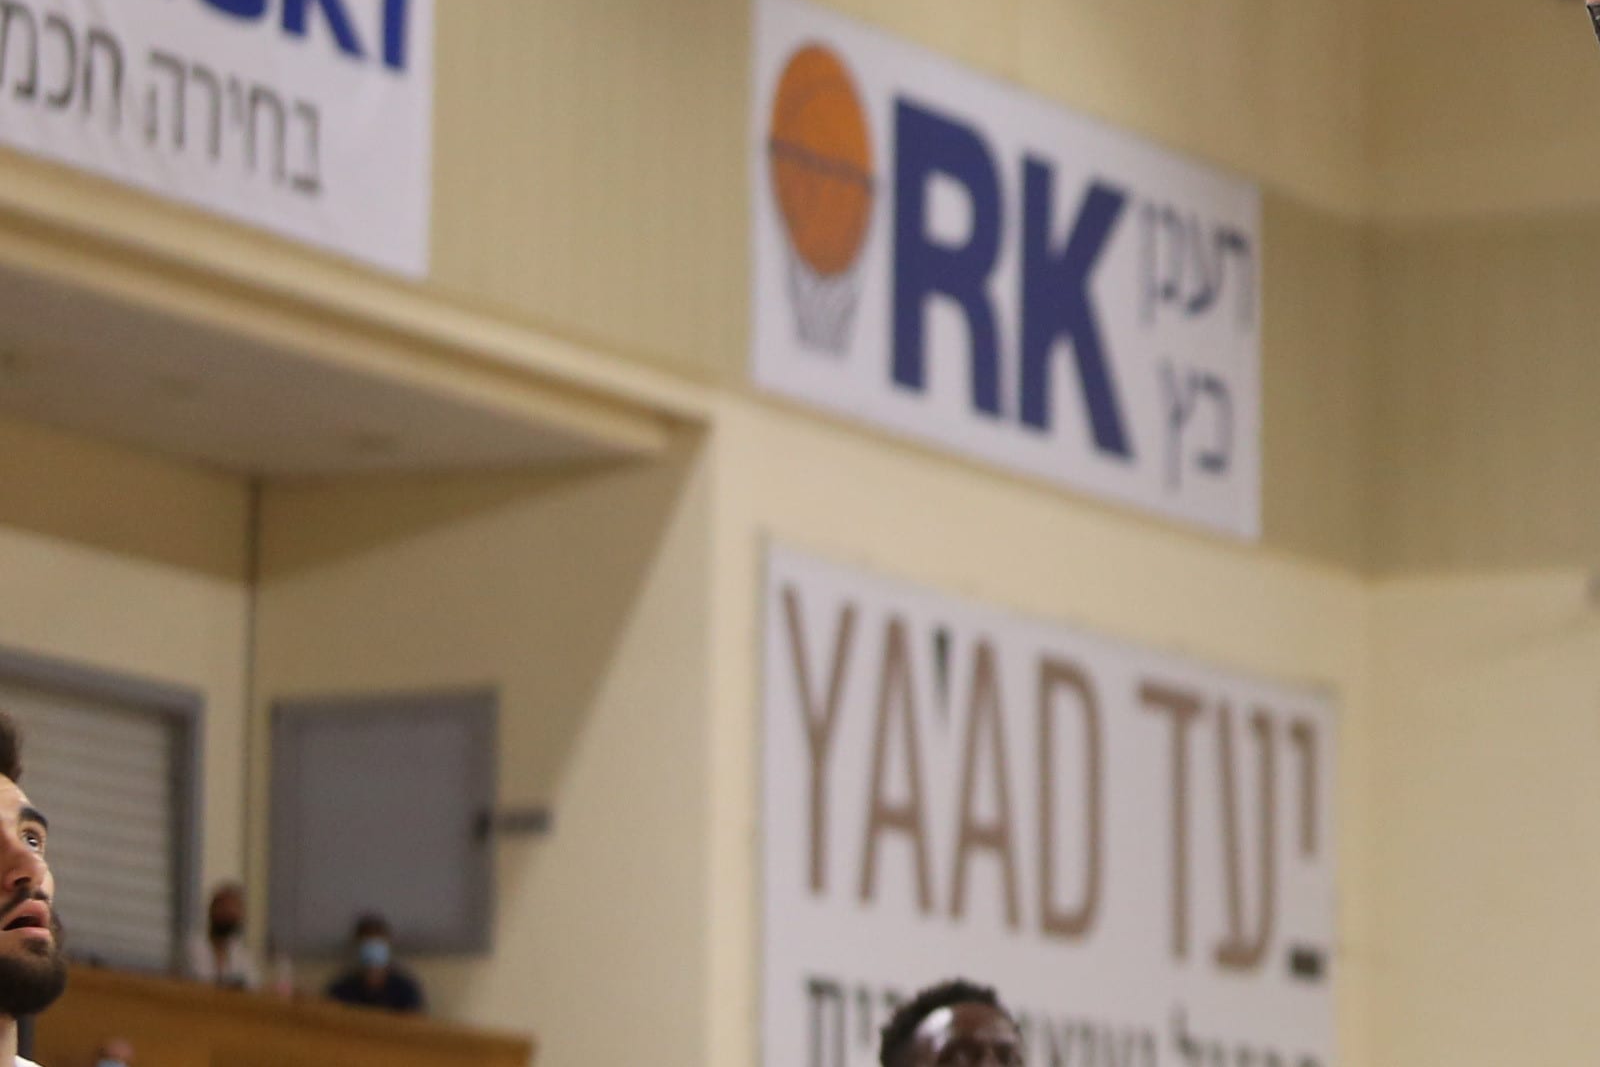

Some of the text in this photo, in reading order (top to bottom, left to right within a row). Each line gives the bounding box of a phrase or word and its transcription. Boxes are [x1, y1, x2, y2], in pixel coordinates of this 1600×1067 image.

[146, 44, 323, 197] בחירה
[891, 93, 1135, 465] RK
[1138, 201, 1256, 331] רענן
[1159, 358, 1237, 497] כץ
[780, 582, 1103, 943] YA'AD
